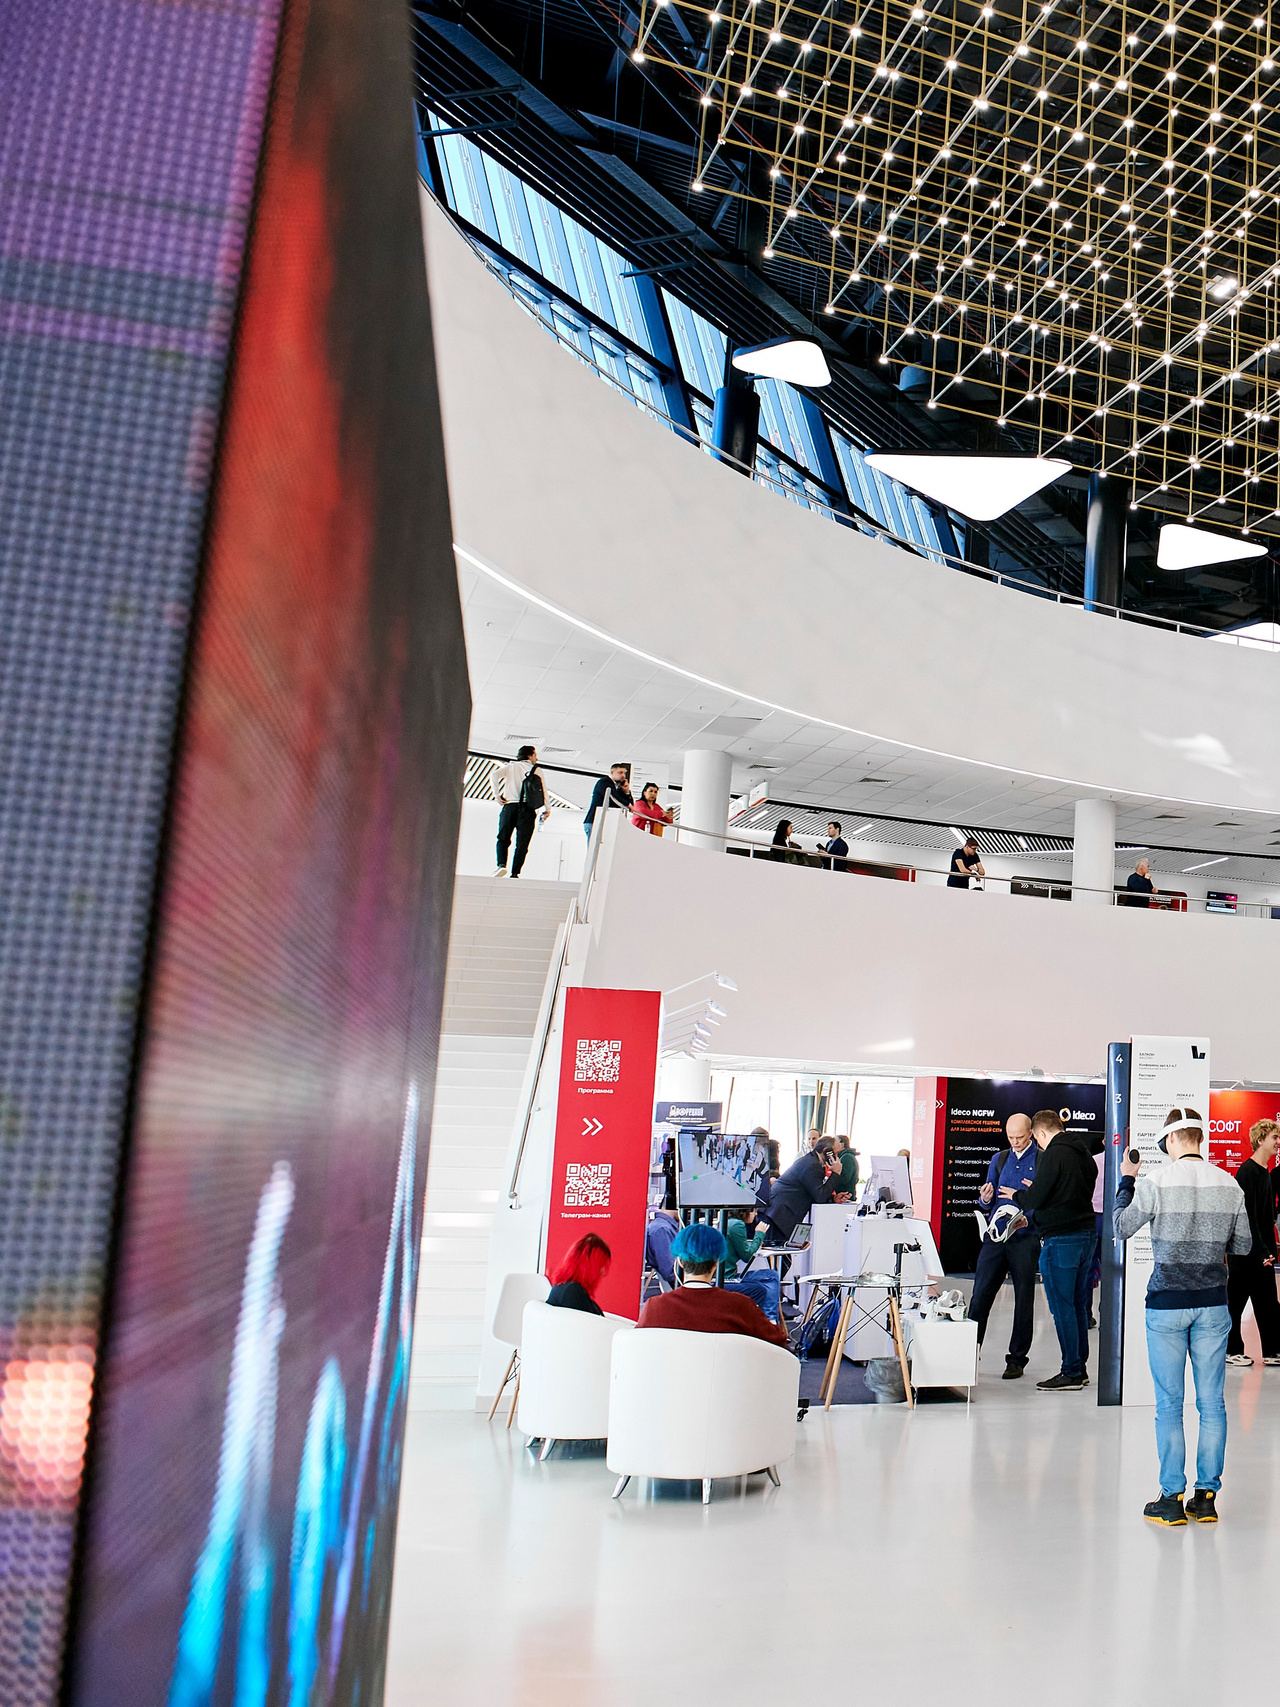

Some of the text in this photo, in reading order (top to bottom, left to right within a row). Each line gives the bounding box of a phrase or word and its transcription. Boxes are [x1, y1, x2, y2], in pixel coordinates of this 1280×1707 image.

[1115, 1053, 1123, 1064] 4
[577, 1087, 614, 1095] Программа
[1114, 1093, 1122, 1104] 3
[950, 1107, 995, 1117] Ideco NGFW
[1208, 1119, 1242, 1133] СОФТ
[1112, 1133, 1121, 1145] 2
[560, 1212, 612, 1220] Телеграм-канал
[1111, 1236, 1116, 1247] 1
